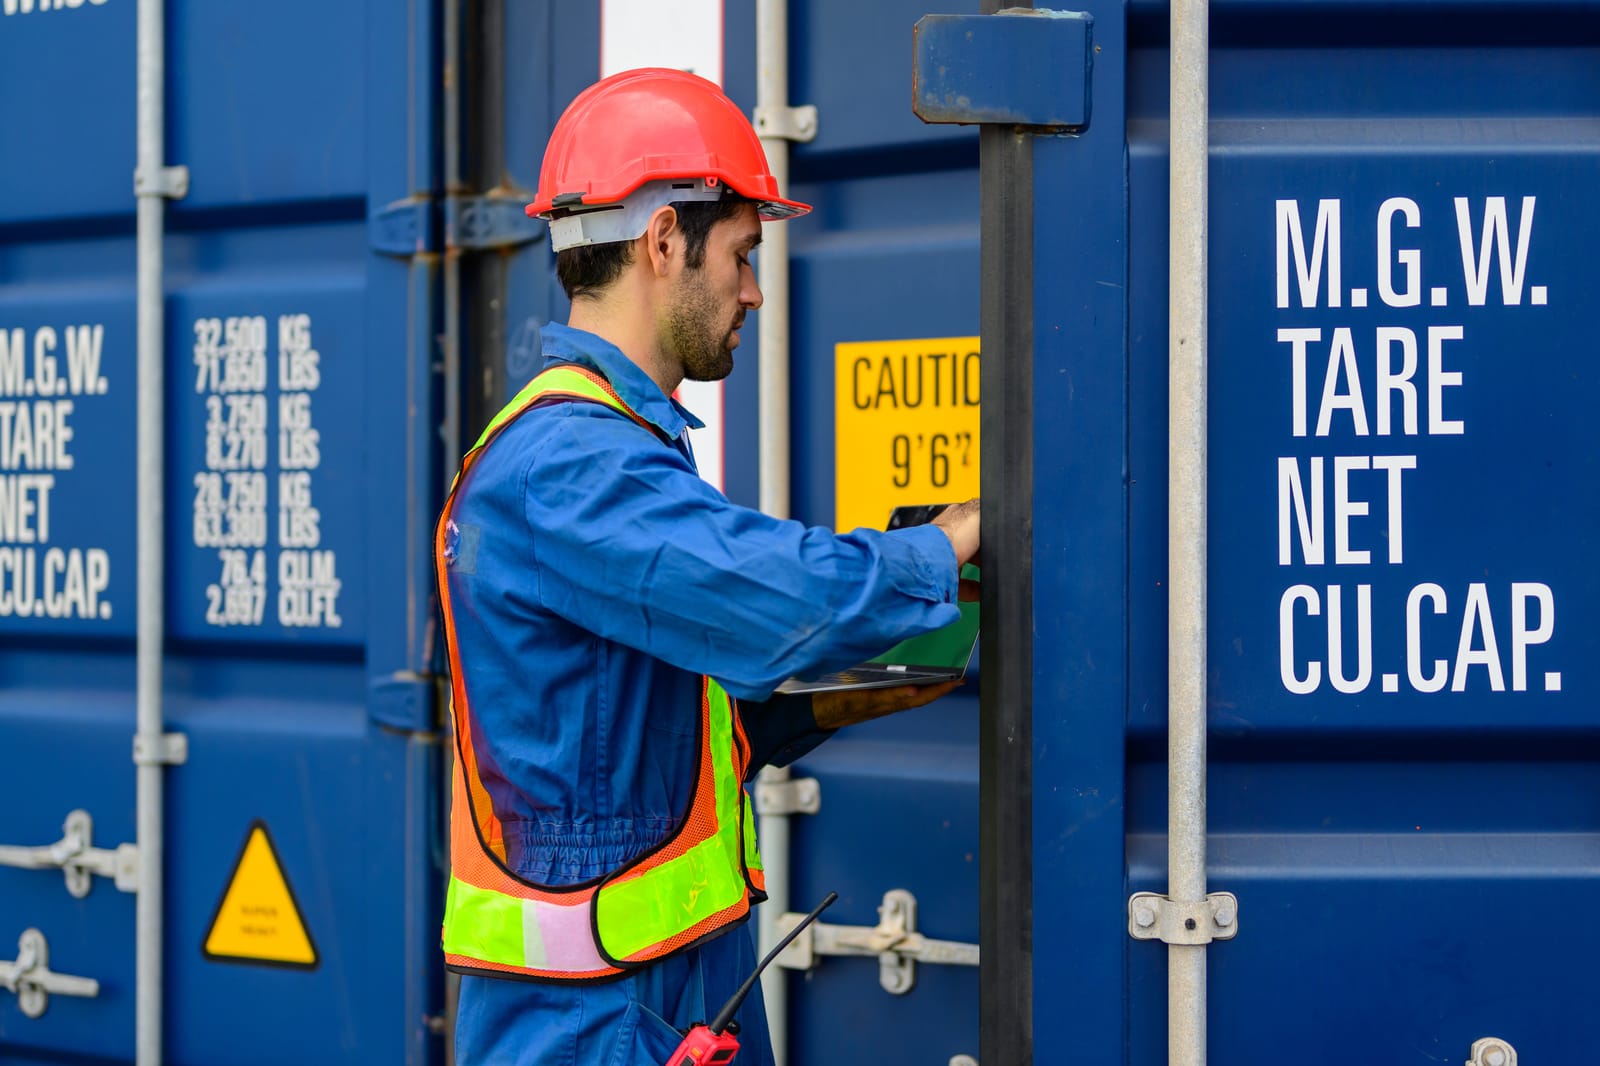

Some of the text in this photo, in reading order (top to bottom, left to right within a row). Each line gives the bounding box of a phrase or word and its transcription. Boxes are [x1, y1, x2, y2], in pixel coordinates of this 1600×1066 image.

[1275, 195, 1548, 309] M.G.W.
[0, 324, 108, 397] M.G.W.
[278, 313, 311, 351] KG
[278, 348, 321, 391] LBS
[1276, 325, 1465, 437] TARE
[0, 400, 74, 470] TARE
[278, 392, 311, 430] KG
[278, 427, 321, 470] LBS
[0, 474, 55, 544] NET
[278, 471, 311, 508] KG
[1277, 455, 1418, 566] NET
[278, 506, 321, 548] LBS
[0, 546, 112, 620] CU.CAP.
[1279, 582, 1562, 694] CU.CAP.
